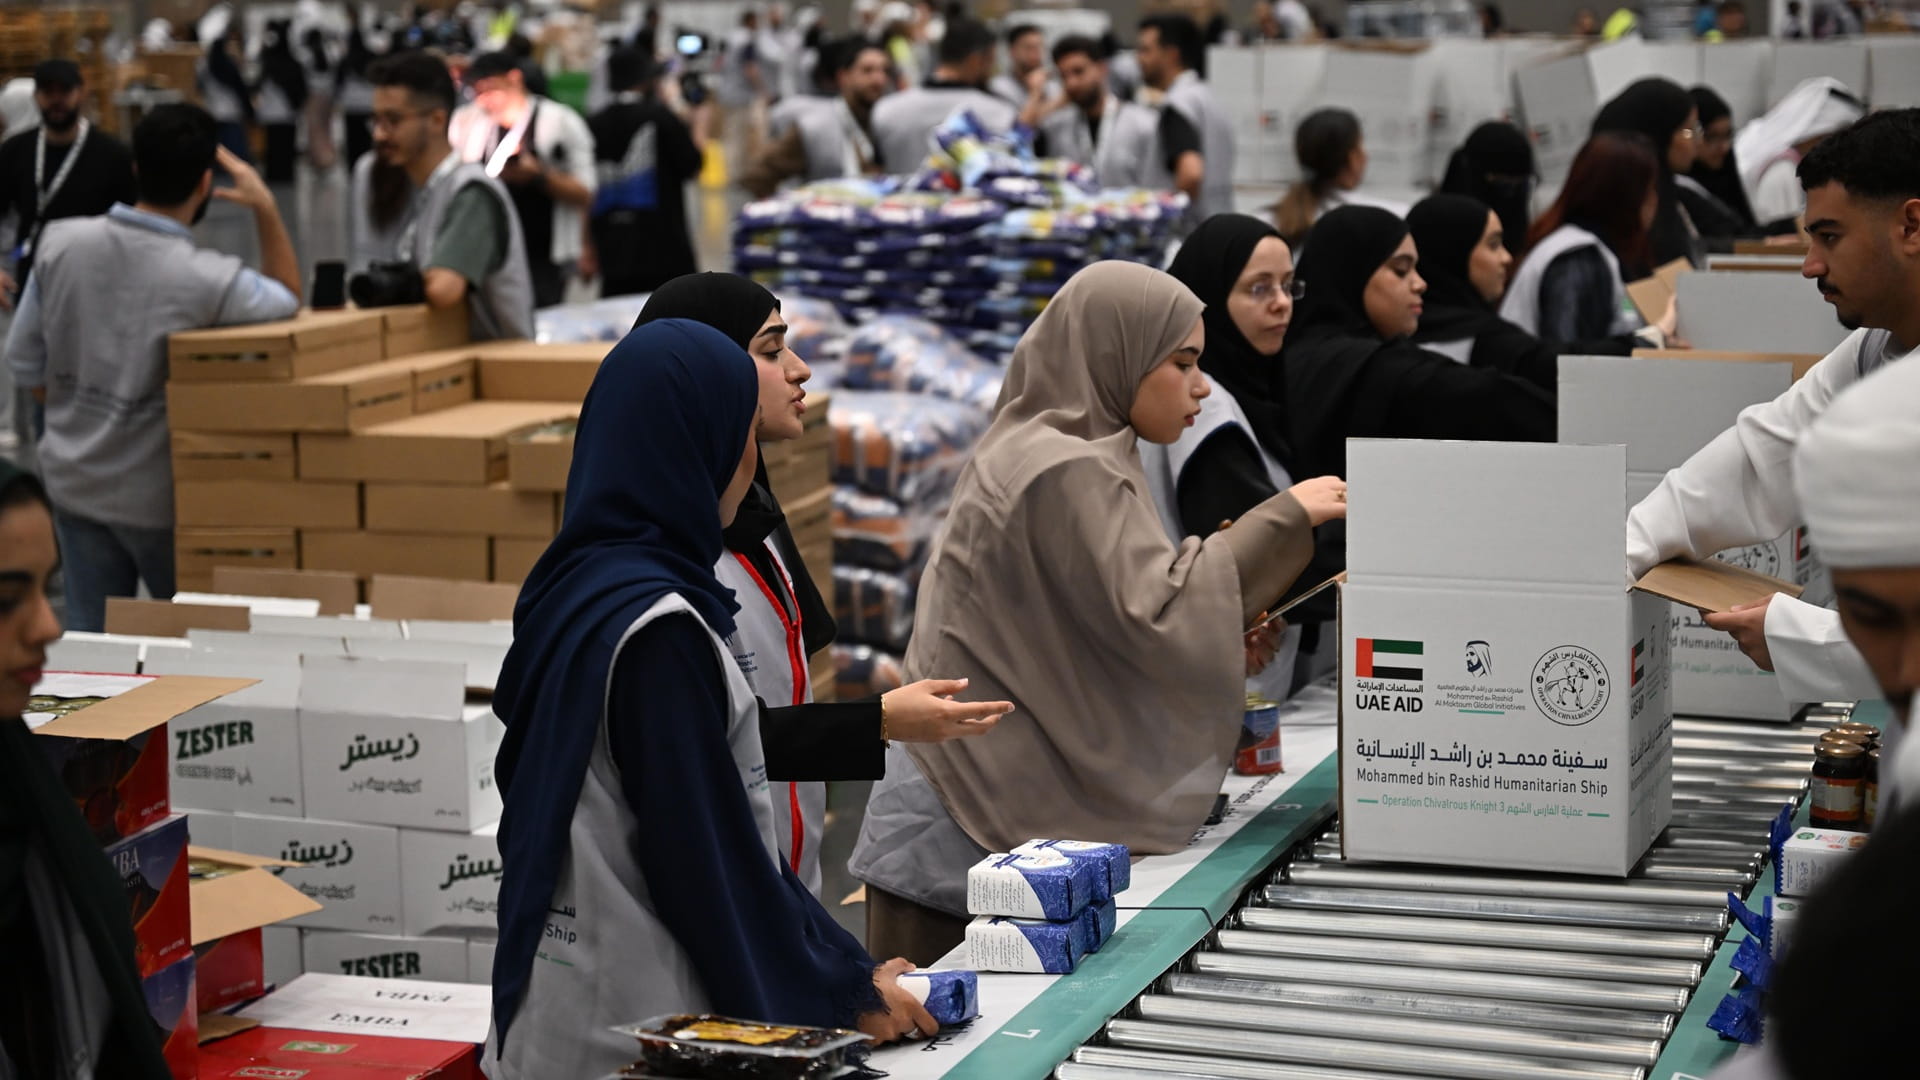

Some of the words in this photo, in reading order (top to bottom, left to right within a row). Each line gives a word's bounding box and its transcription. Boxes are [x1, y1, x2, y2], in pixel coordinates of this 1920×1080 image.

[1385, 683, 1424, 693] المساعدات
[1446, 692, 1484, 701] Mohammed
[1491, 694, 1514, 702] Rashid
[1356, 694, 1391, 711] UAE
[1393, 696, 1423, 713] AID
[1442, 700, 1473, 708] Maktoum
[1473, 701, 1494, 709] Global
[1494, 702, 1526, 711] Initiatives
[1537, 686, 1558, 716] OPERATION
[1557, 708, 1593, 720] CHIVALROUS
[1590, 689, 1605, 710] KNIGHT
[175, 720, 254, 760] ZESTER
[339, 732, 420, 771] زيستر
[1356, 738, 1425, 767] الإنسانية
[1430, 741, 1472, 768] راشد
[1477, 749, 1492, 769] بن
[1497, 752, 1547, 767] محمد
[1552, 749, 1607, 773] سفينة
[1357, 767, 1424, 785] Mohammed
[1427, 772, 1446, 786] bin
[1449, 773, 1490, 789] Rashid
[1494, 775, 1577, 793] Humanitarian
[1580, 779, 1608, 797] Ship
[1382, 794, 1421, 807] Operation
[1423, 796, 1468, 810] Chivalrous
[1470, 799, 1497, 813] Knight
[1499, 801, 1505, 811] 3
[545, 922, 577, 944] Ship
[331, 1012, 409, 1027] EMBA
